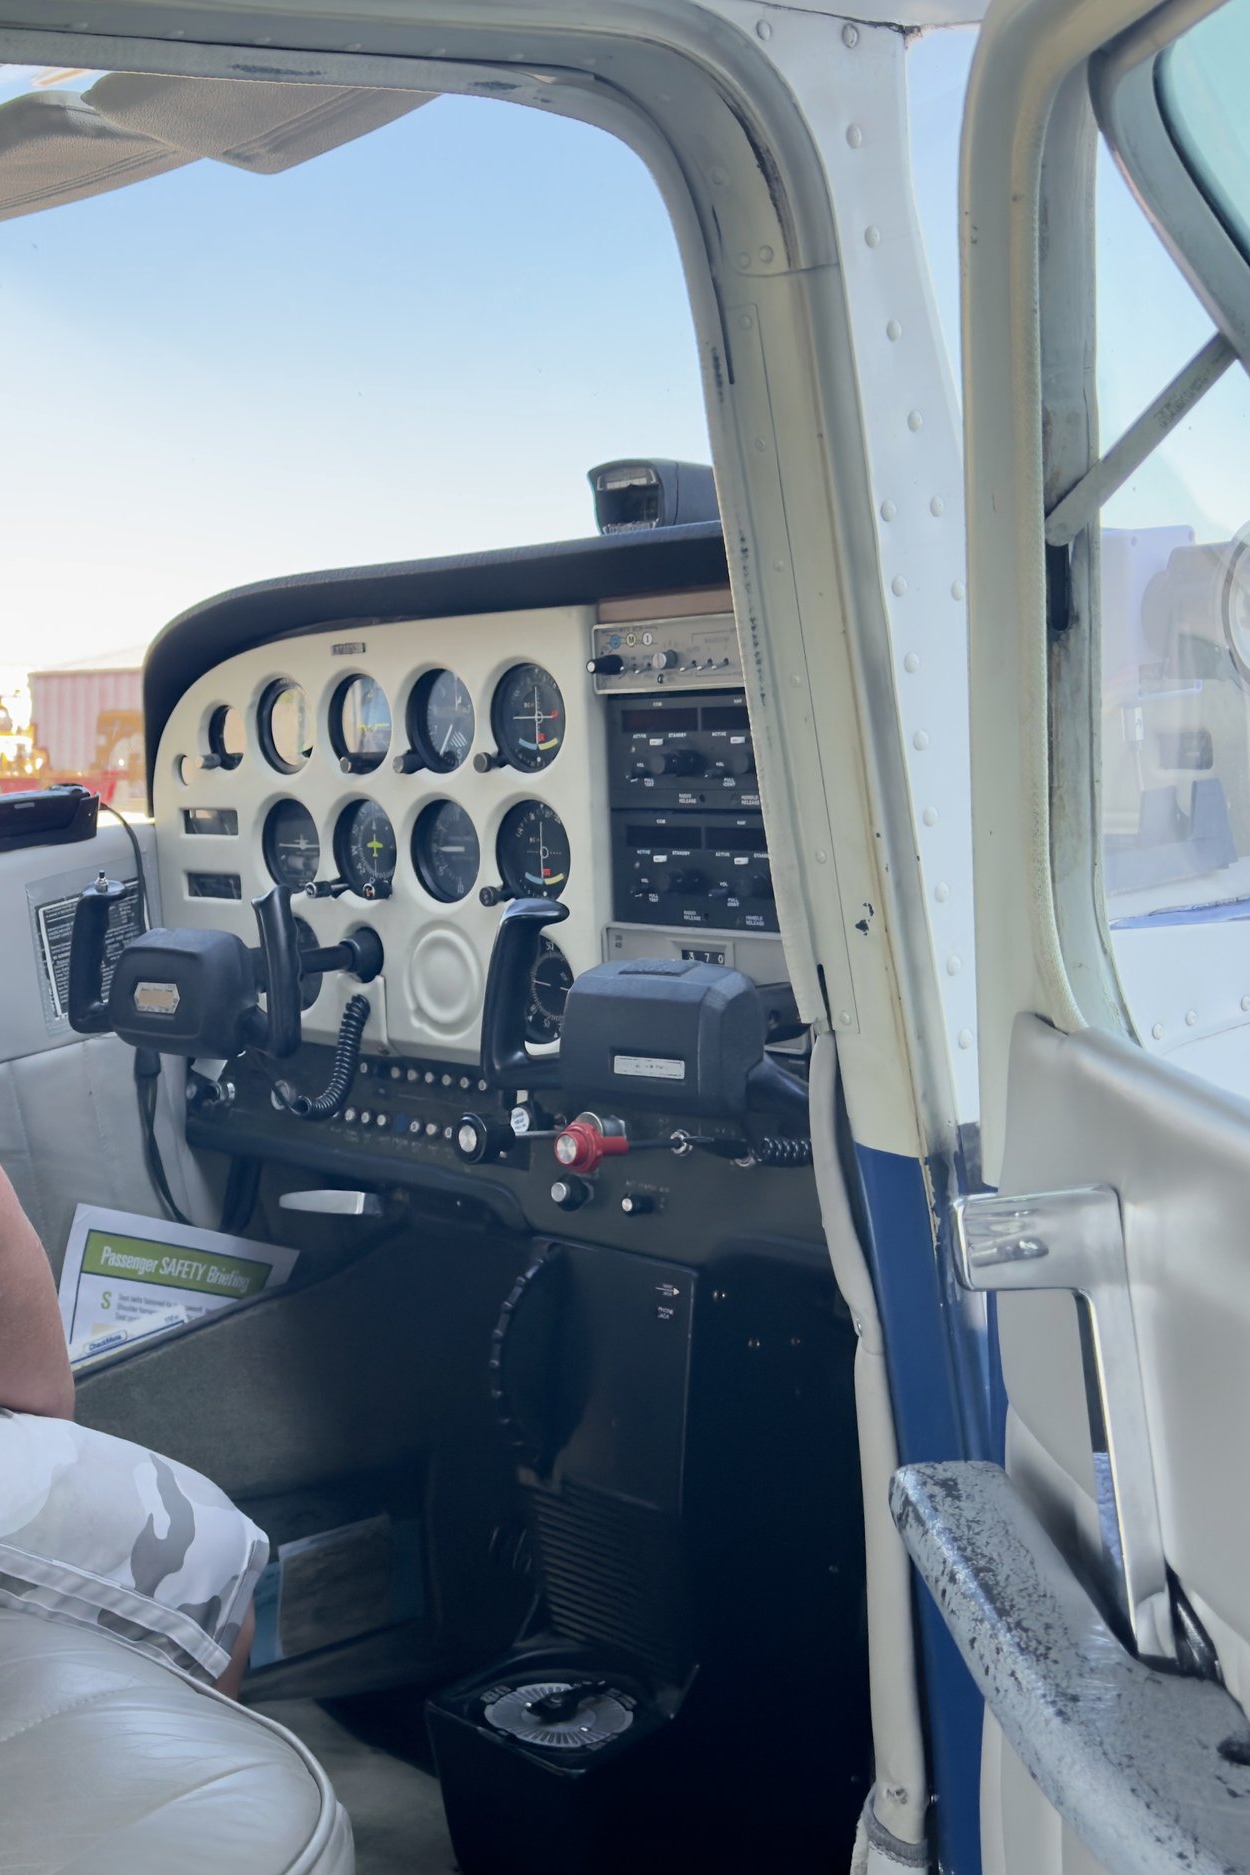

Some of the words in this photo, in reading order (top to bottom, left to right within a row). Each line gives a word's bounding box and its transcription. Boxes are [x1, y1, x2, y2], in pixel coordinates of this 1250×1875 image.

[100, 1246, 158, 1275] Passenger
[159, 1257, 207, 1280] SAFETY
[206, 1266, 250, 1293] Briefing
[101, 1291, 112, 1310] S
